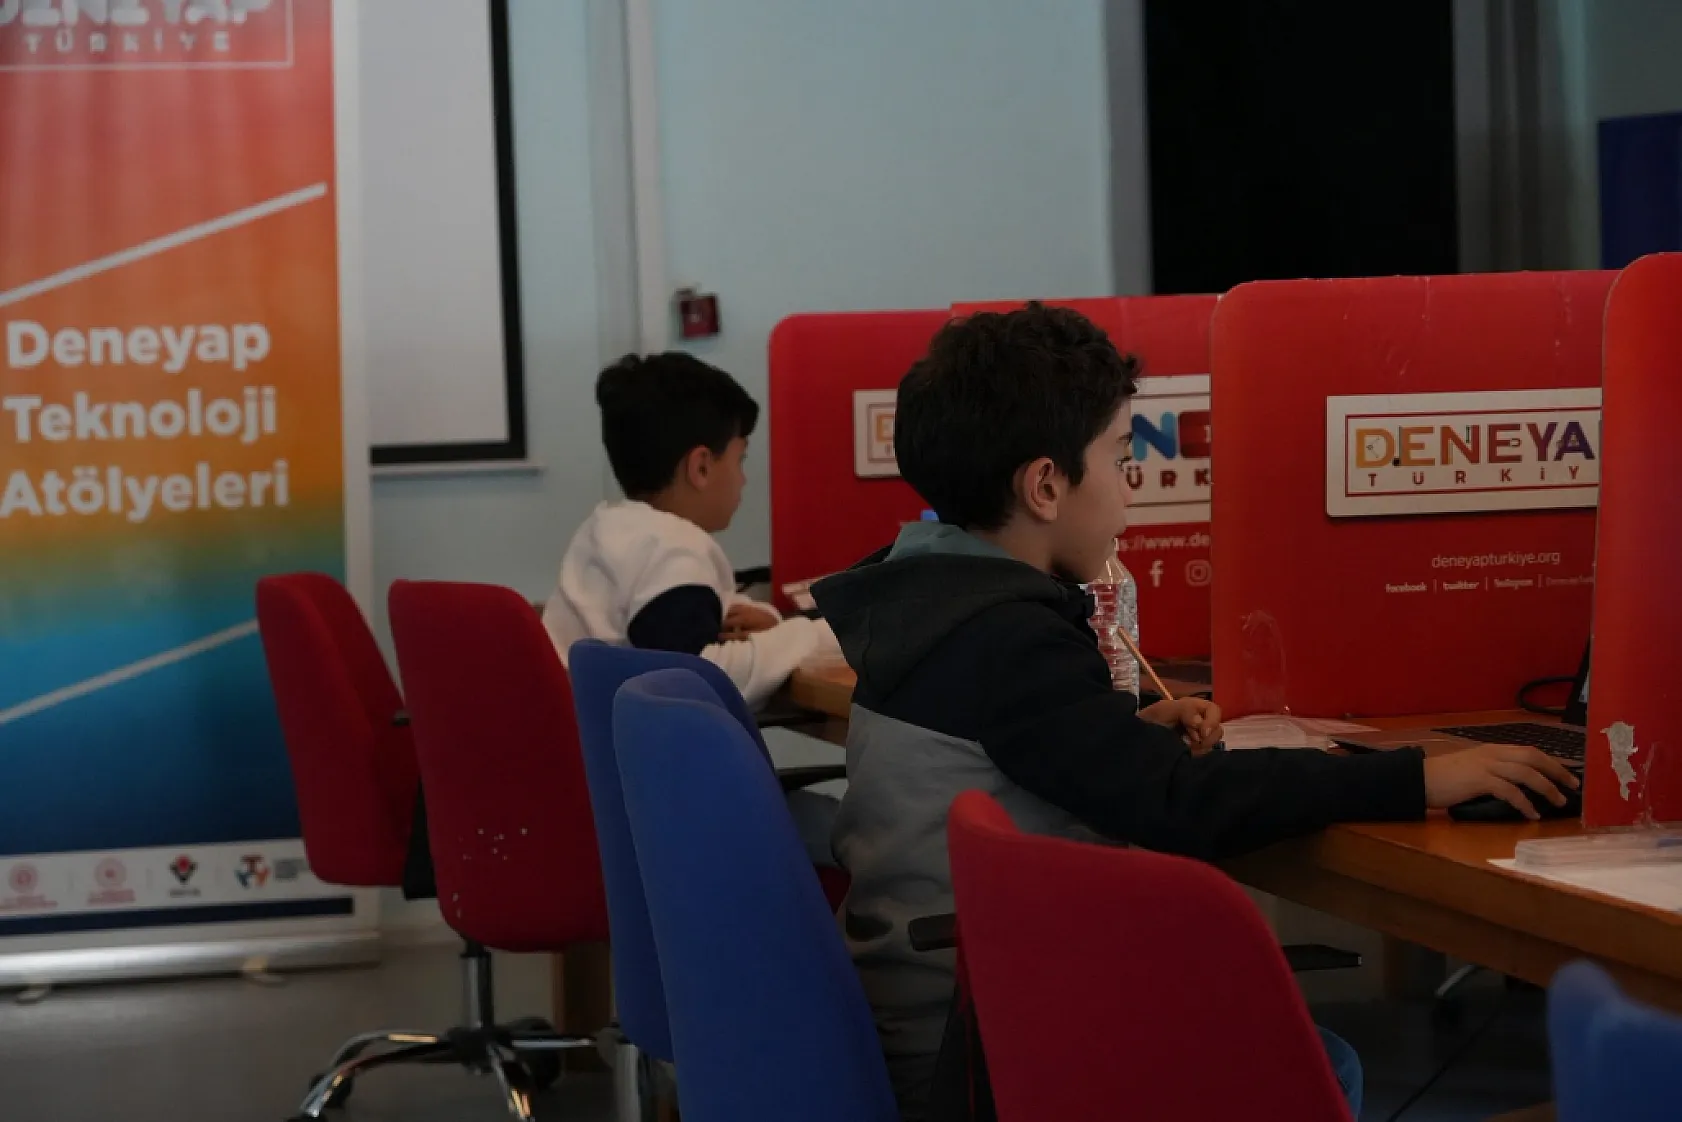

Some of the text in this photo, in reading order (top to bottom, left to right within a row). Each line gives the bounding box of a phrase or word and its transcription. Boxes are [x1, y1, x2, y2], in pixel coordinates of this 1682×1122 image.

[6, 320, 271, 373] Deneyap
[2, 386, 278, 444] Teknoloji
[0, 459, 289, 522] Atölyeleri
[1431, 551, 1561, 569] deneyapturkiye.org
